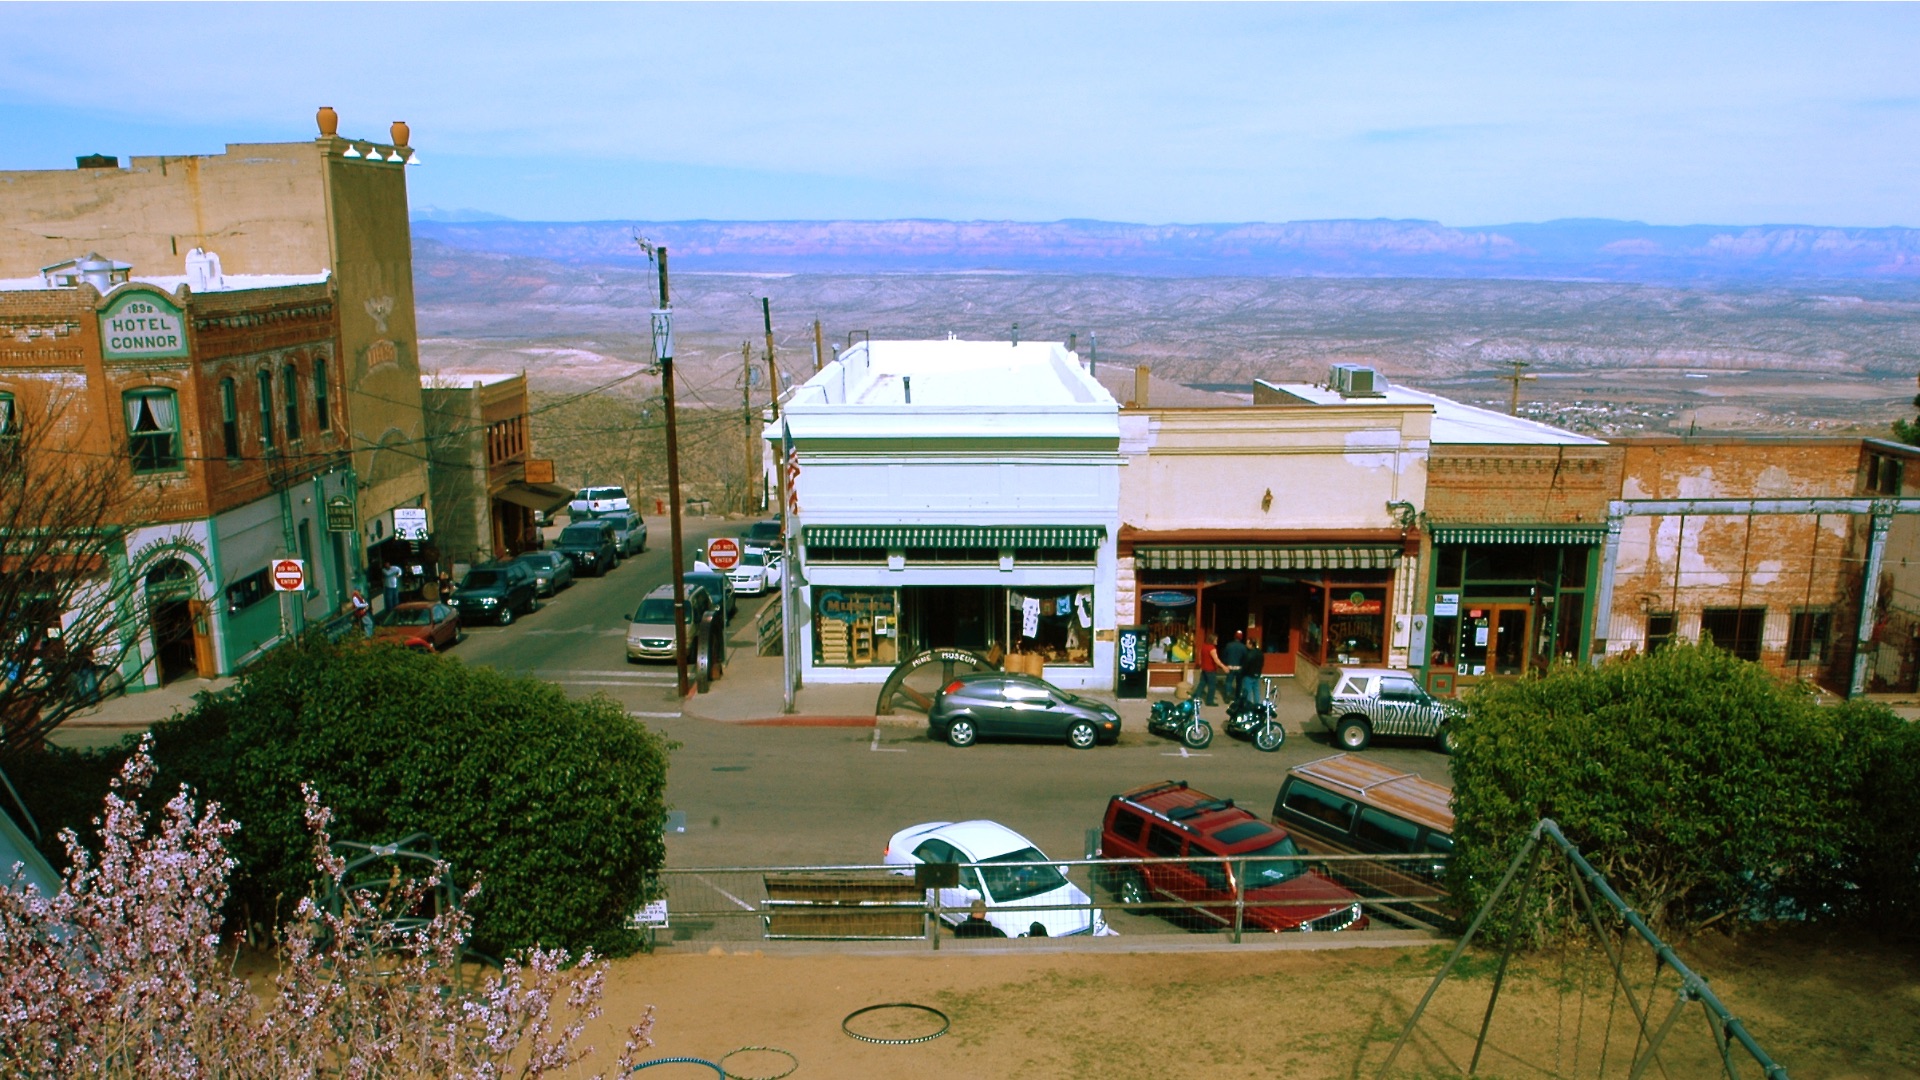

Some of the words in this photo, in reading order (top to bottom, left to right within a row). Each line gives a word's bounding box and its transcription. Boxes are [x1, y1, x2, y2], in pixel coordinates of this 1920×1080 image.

[127, 303, 153, 314] 1898
[112, 318, 171, 332] HOTEL
[111, 335, 177, 349] CONNOR
[912, 654, 932, 668] MINE
[941, 652, 977, 666] MUSEUM
